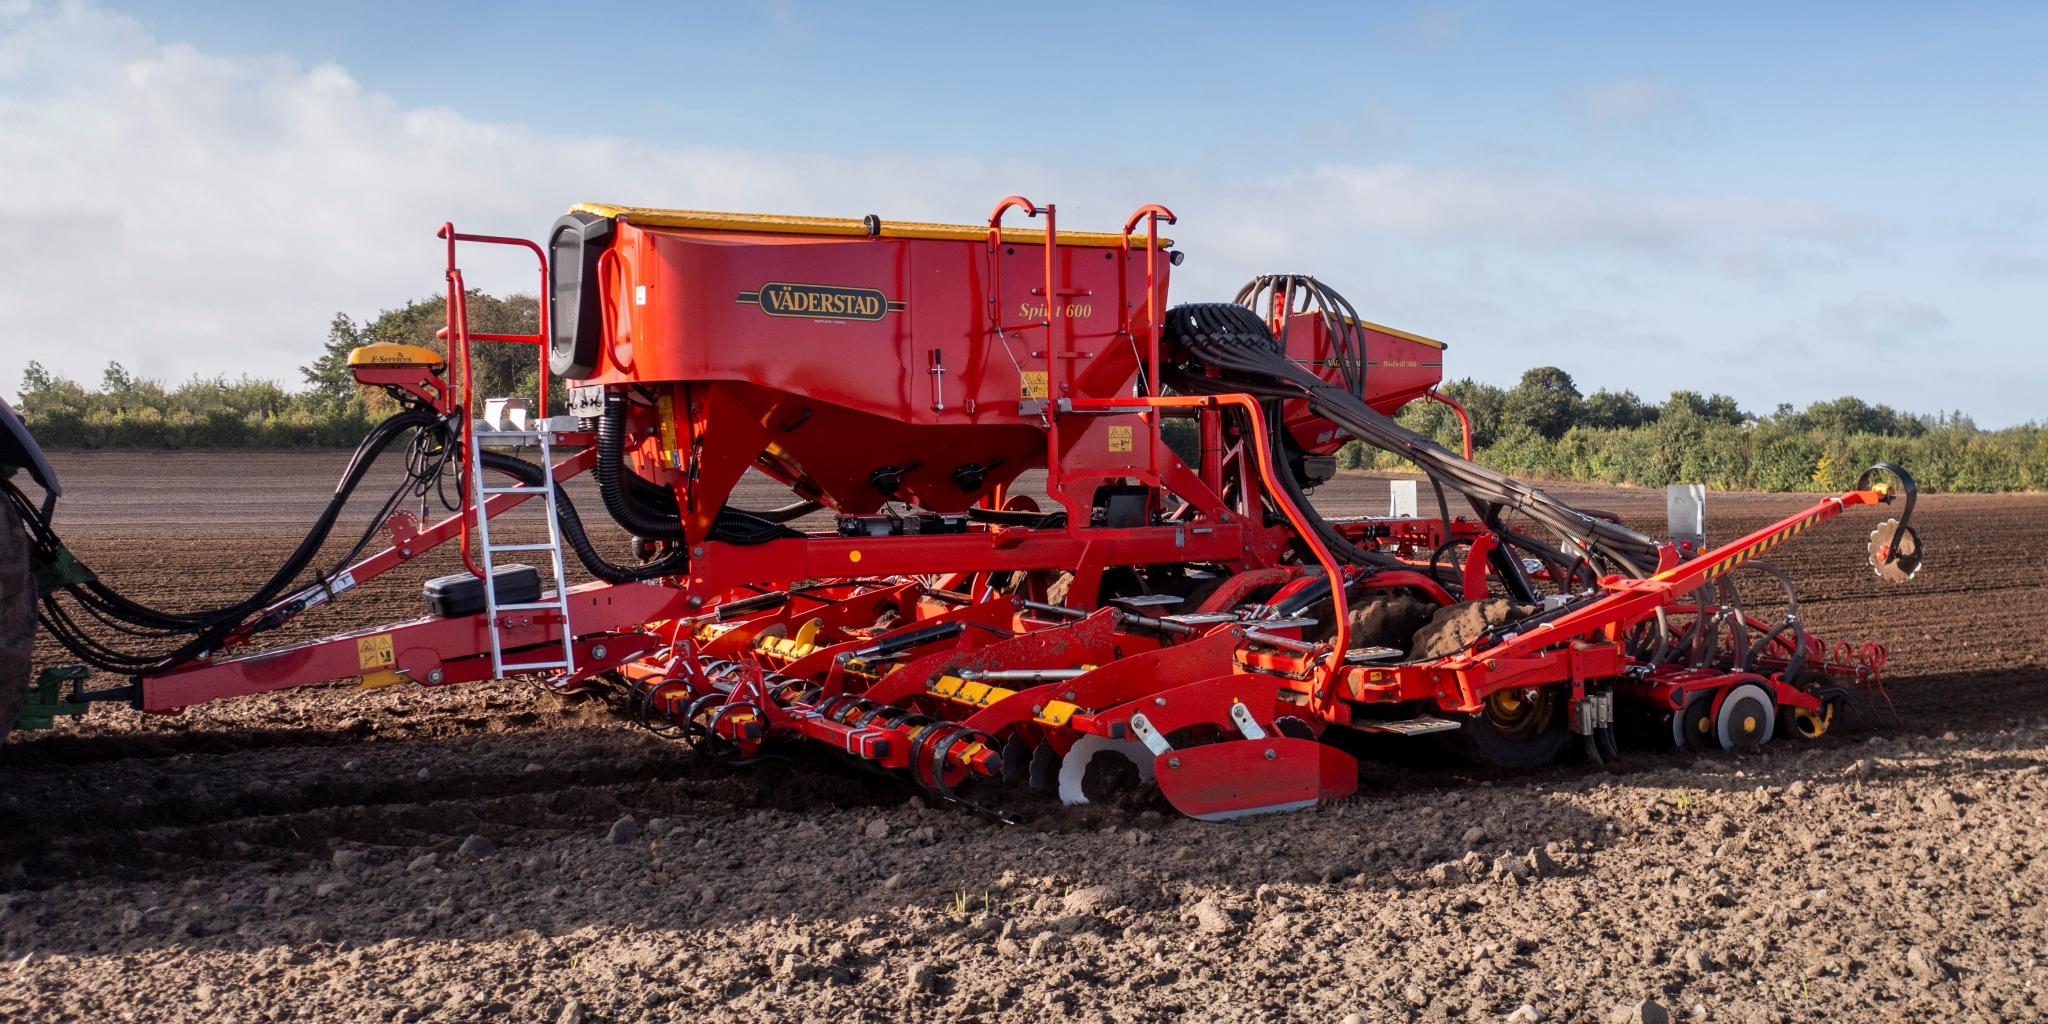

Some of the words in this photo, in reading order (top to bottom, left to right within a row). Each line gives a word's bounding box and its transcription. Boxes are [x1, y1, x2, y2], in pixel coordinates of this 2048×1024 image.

[768, 286, 880, 315] VÄDERSTAD
[1019, 303, 1061, 320] Spit
[1066, 304, 1092, 318] 600
